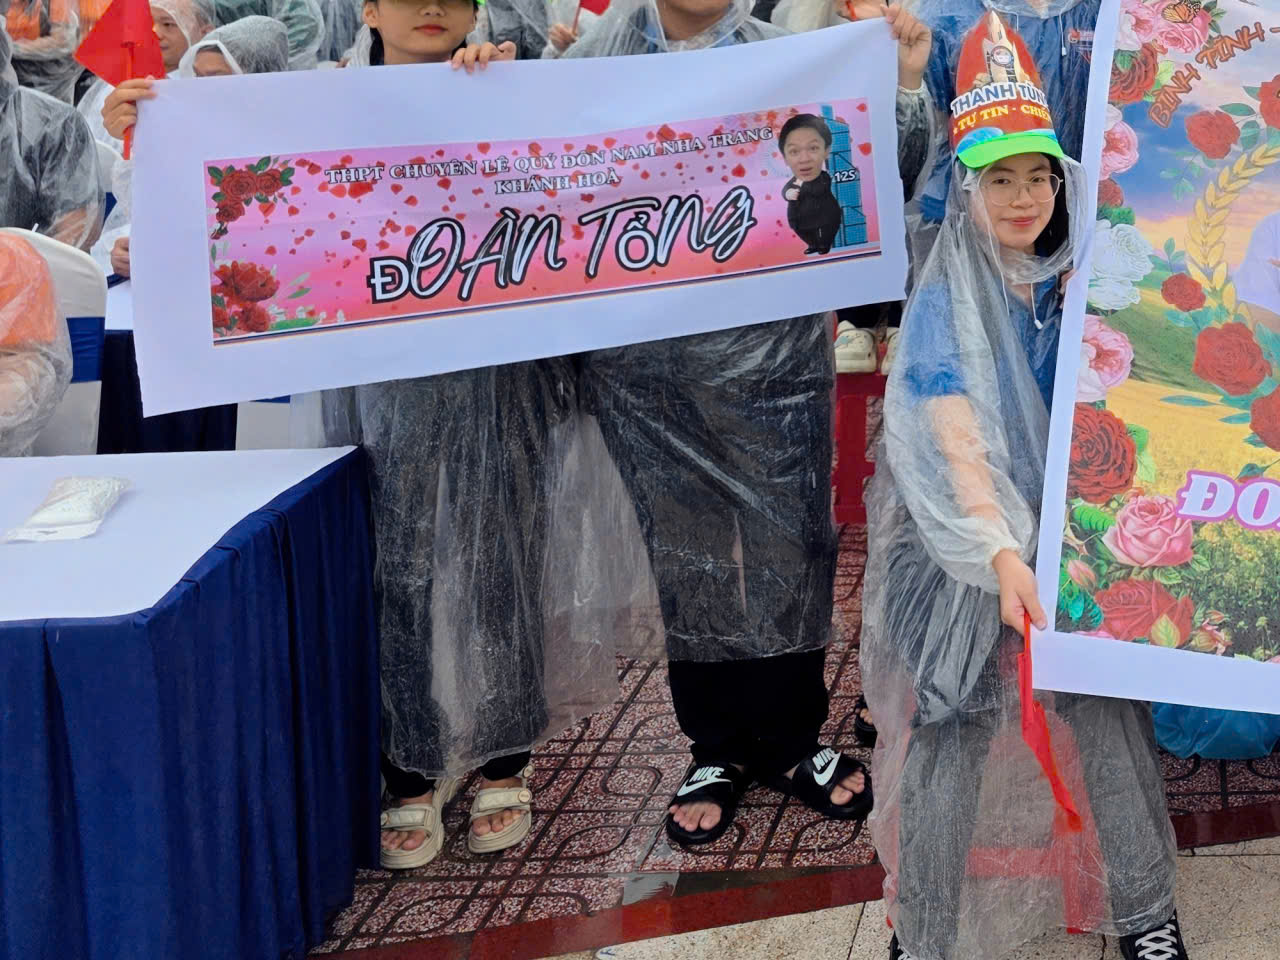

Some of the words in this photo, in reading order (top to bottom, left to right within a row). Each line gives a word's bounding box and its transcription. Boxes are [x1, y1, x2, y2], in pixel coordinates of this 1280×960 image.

[951, 83, 1016, 118] THANH
[957, 111, 978, 129] TỰ
[980, 104, 1009, 121] TIN
[325, 165, 385, 185] THPT
[388, 156, 479, 183] CHUYÊN
[483, 151, 511, 175] LÊ
[609, 139, 658, 162] NAM
[659, 136, 704, 158] NHA
[708, 124, 774, 150] TRANG
[494, 169, 572, 196] KHÁNH
[577, 164, 621, 188] HOÀ
[689, 766, 726, 783] NIKE
